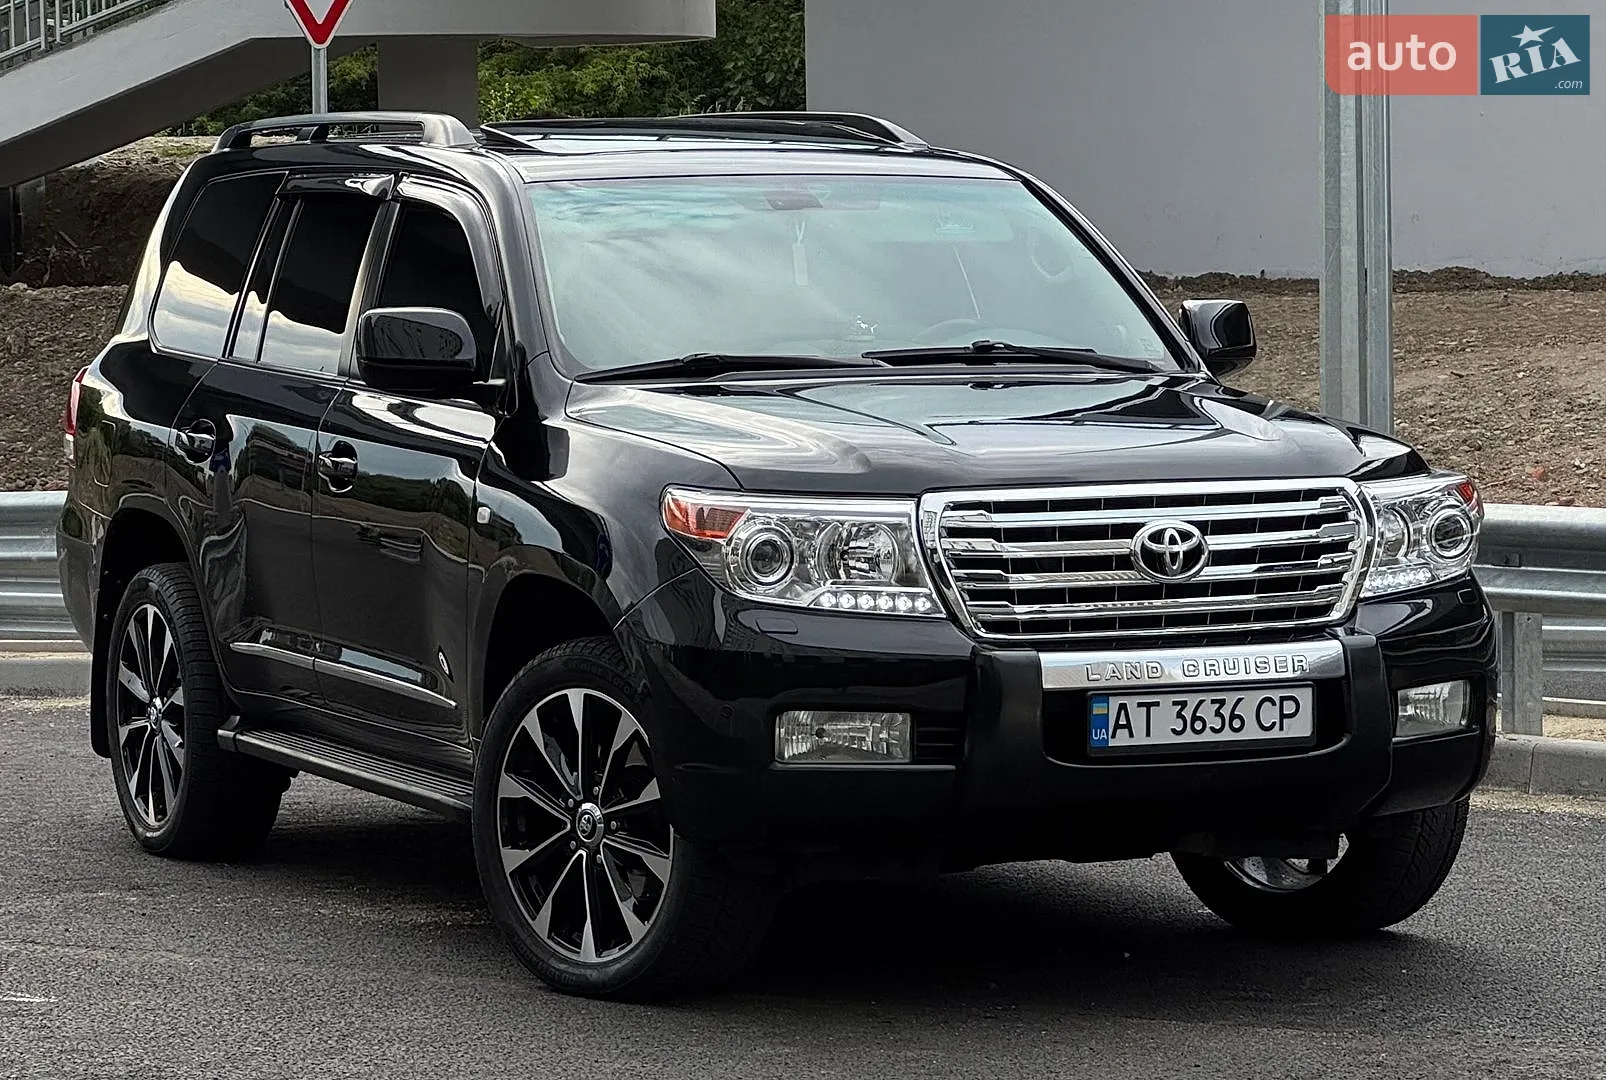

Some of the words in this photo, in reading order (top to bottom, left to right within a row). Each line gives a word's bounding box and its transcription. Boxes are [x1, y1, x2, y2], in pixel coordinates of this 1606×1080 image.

[1085, 660, 1163, 682] LAND
[1181, 655, 1310, 677] CRUISER
[1110, 700, 1160, 740] AT
[1170, 696, 1246, 737] 3636
[1255, 694, 1301, 733] CP
[1092, 728, 1108, 741] UA
